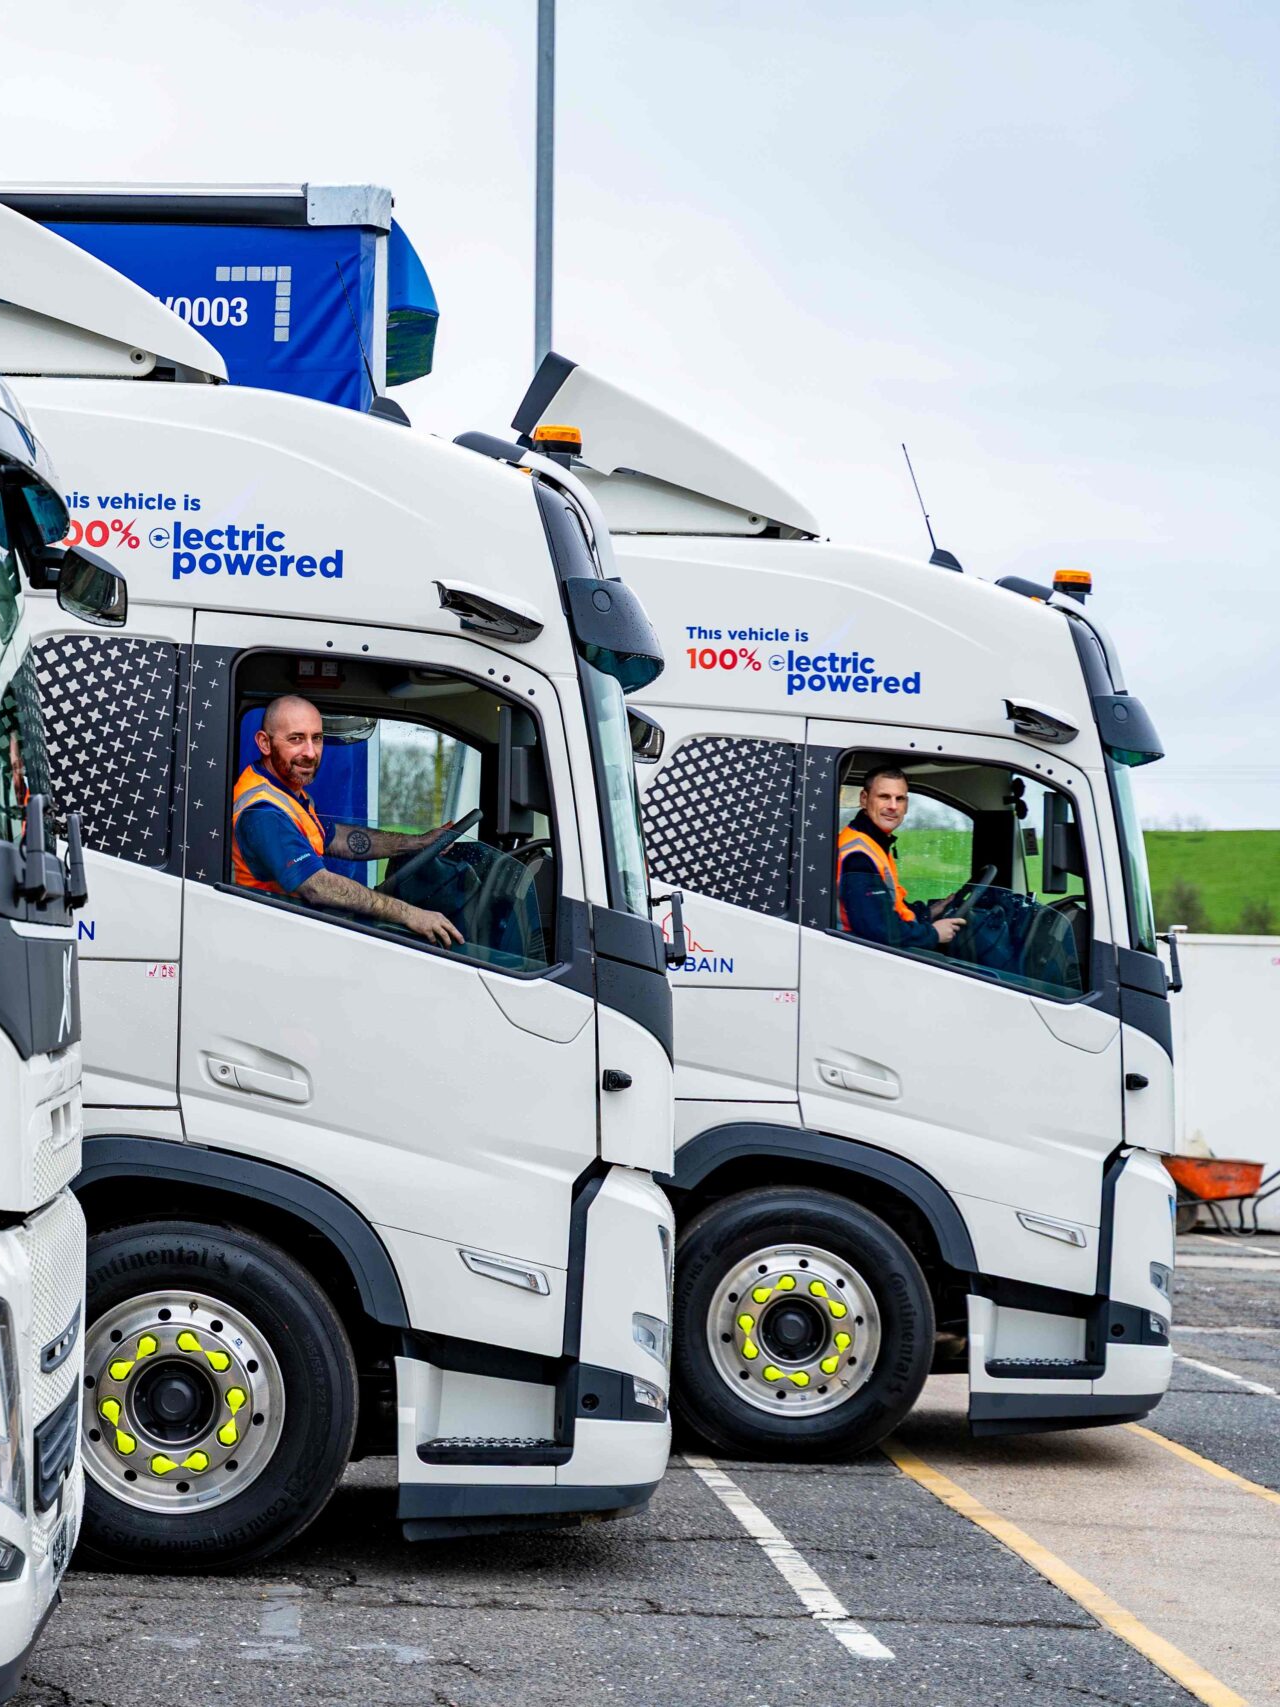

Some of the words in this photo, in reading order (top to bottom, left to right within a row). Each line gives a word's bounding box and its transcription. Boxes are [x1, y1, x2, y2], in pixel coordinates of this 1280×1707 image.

[97, 493, 177, 511] vehicle
[183, 494, 201, 511] is
[60, 517, 141, 549] 00%
[172, 550, 344, 580] powered
[686, 626, 722, 640] This
[728, 627, 790, 642] vehicle
[795, 628, 809, 642] is
[686, 647, 762, 671] 100%
[787, 672, 921, 696] powered
[87, 1246, 209, 1294] ontinental
